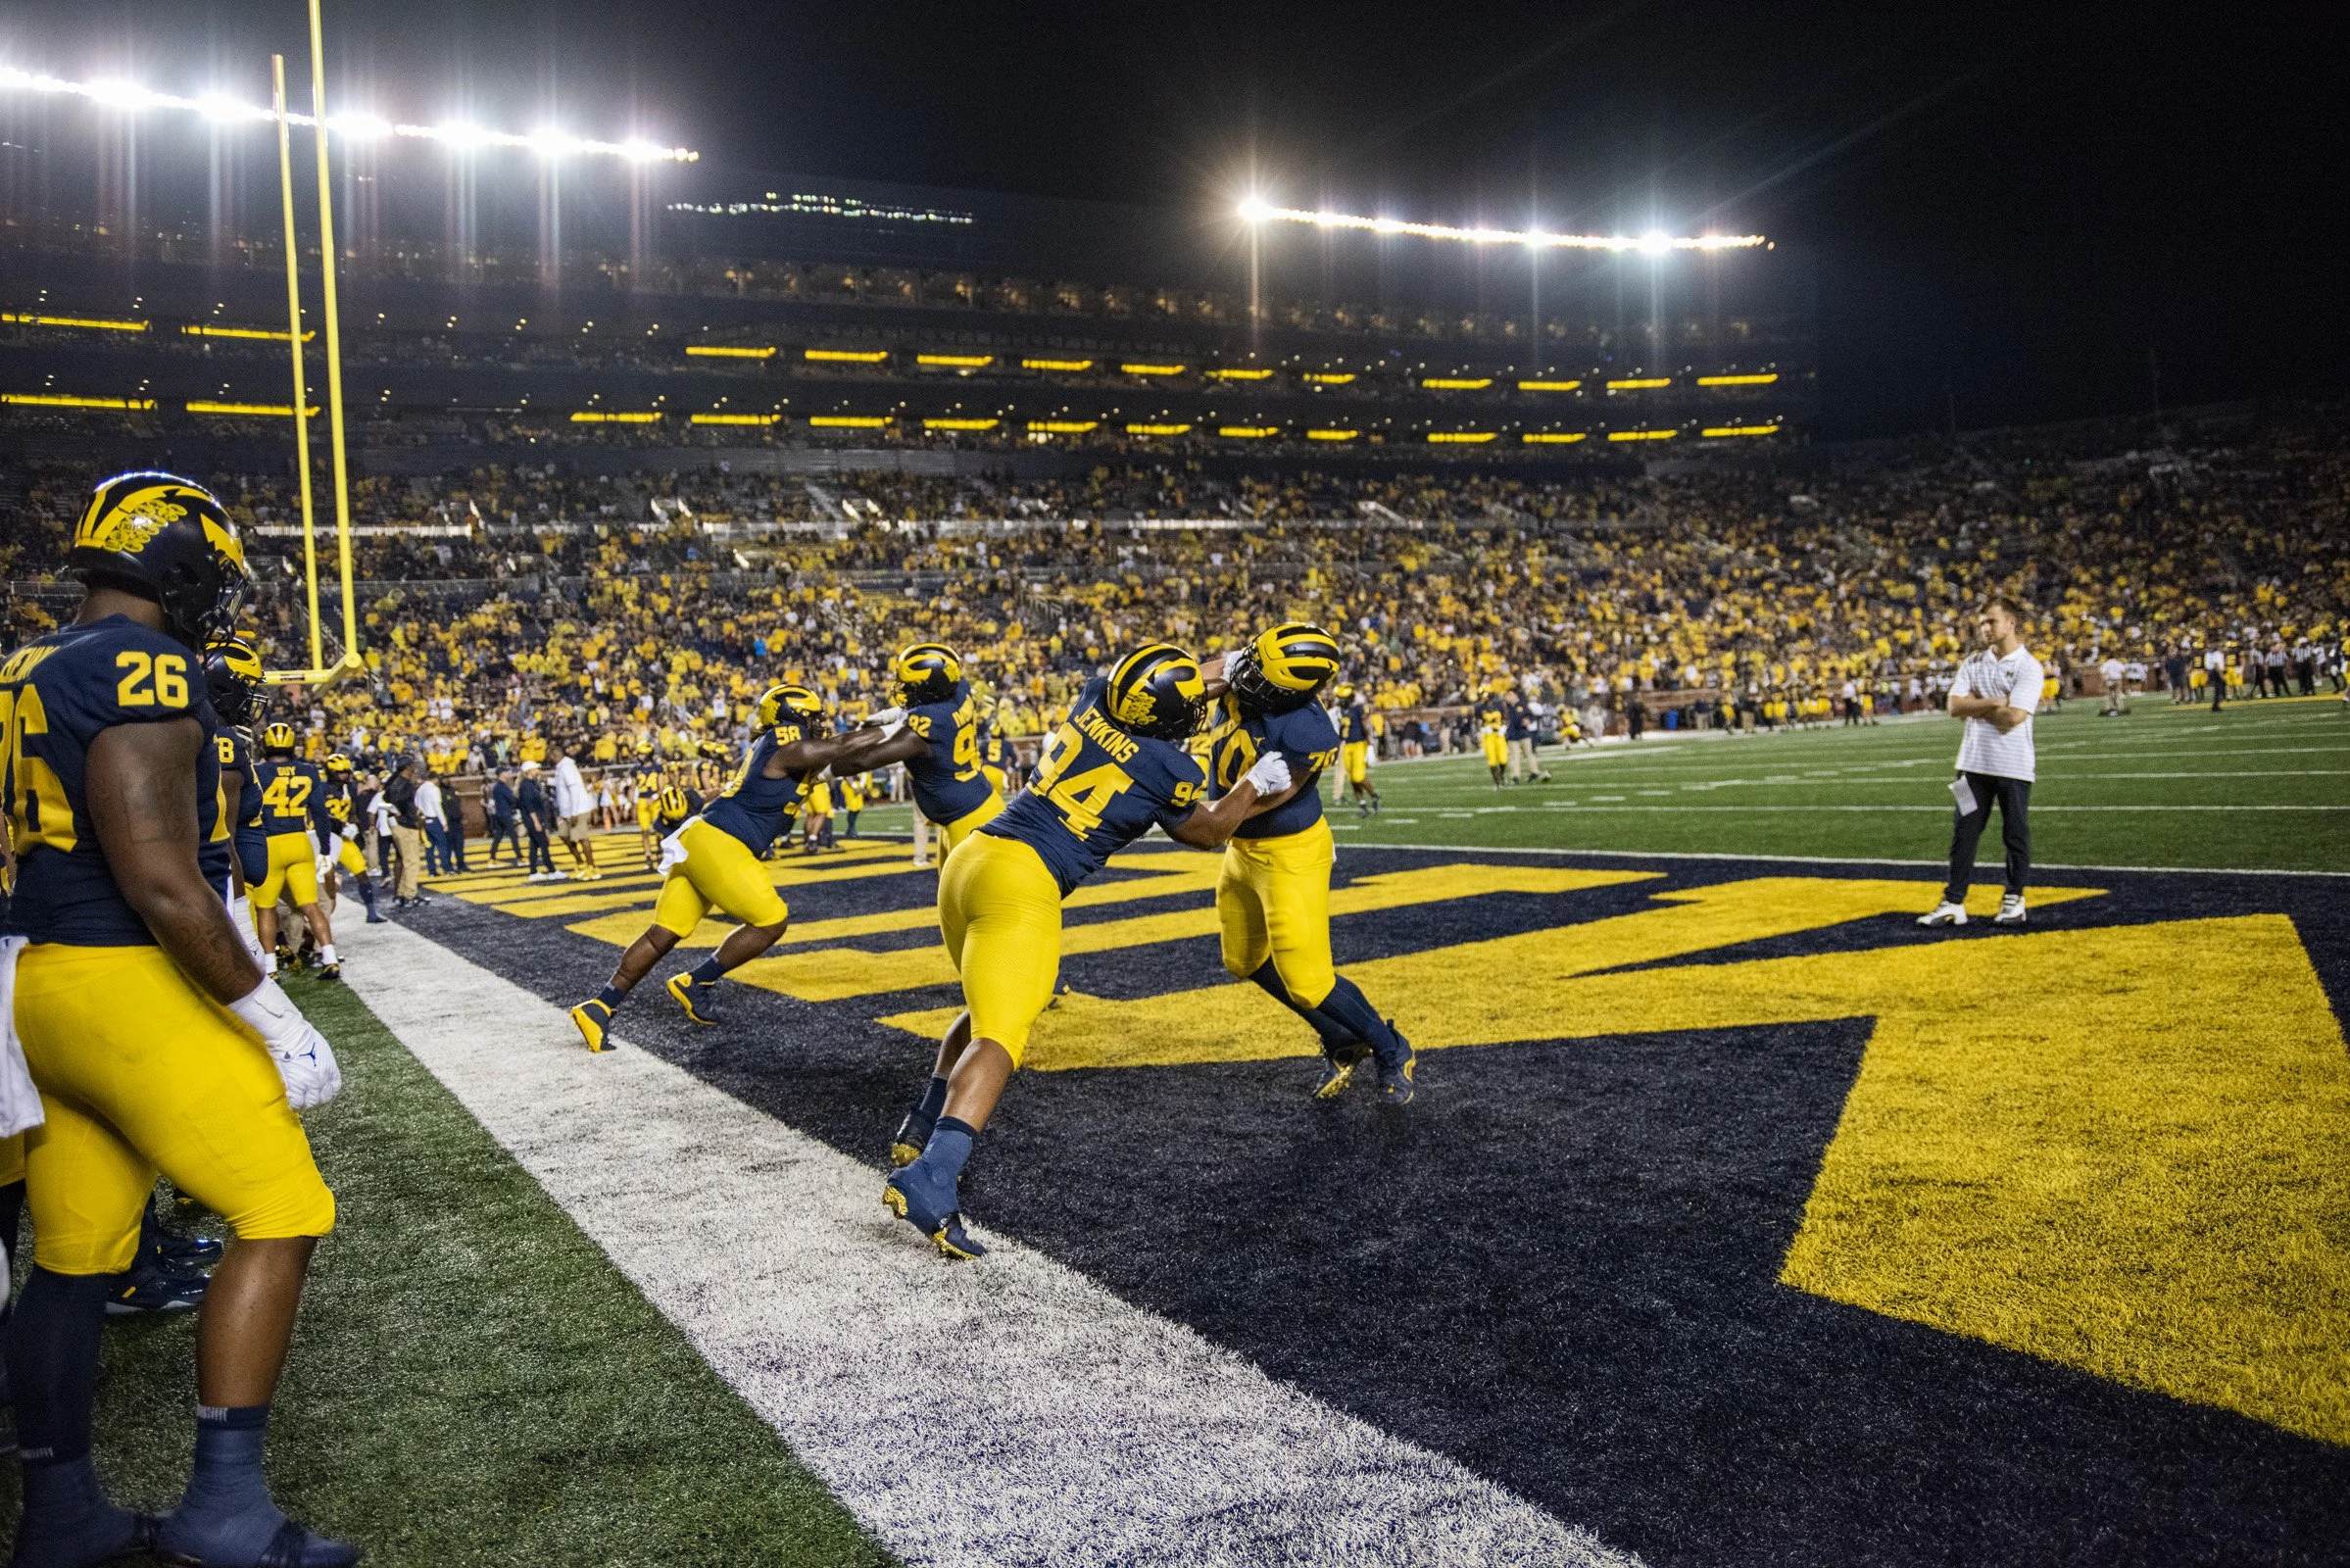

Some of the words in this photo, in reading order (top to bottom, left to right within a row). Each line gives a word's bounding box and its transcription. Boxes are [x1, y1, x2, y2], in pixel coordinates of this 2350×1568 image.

[116, 651, 189, 709] 26
[908, 714, 932, 738] 92
[953, 709, 981, 782] 9
[1074, 706, 1140, 763] JENKINS
[263, 775, 313, 817] 42
[276, 765, 296, 777] GUY
[1026, 722, 1135, 843] 94
